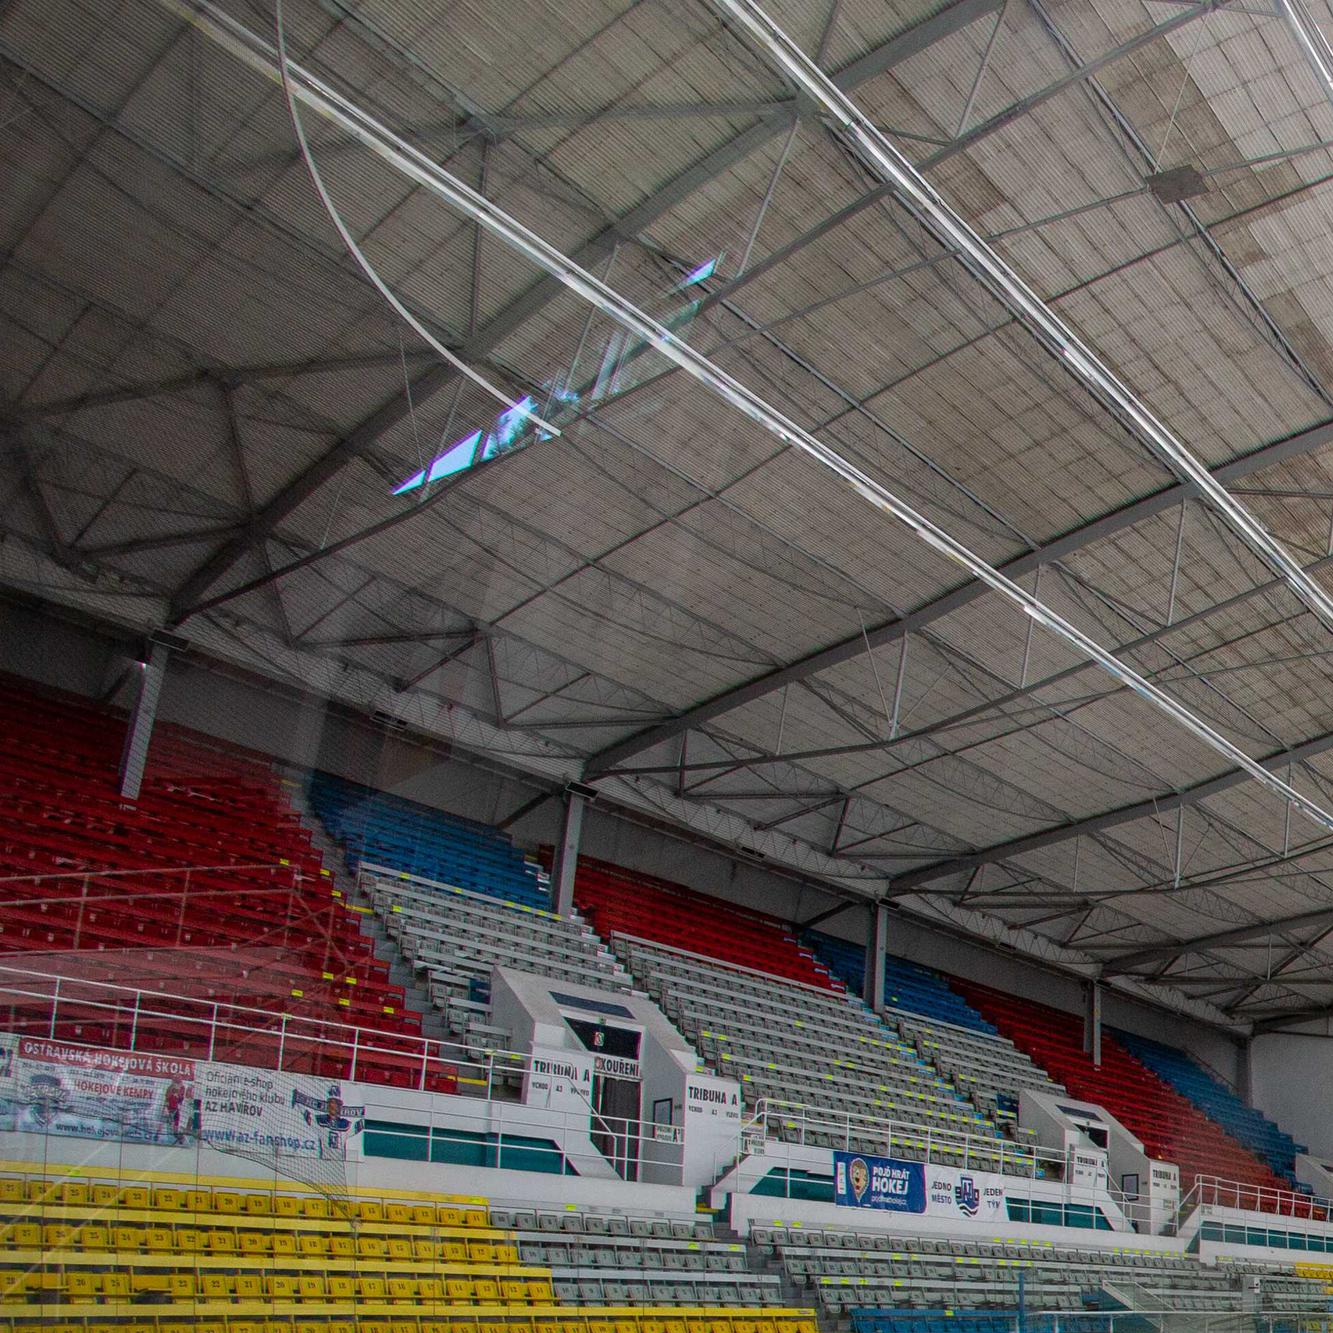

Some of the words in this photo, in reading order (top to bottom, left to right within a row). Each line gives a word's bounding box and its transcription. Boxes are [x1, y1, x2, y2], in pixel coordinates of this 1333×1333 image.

[23, 1041, 92, 1065] OSTRAVSKÁ
[155, 1057, 192, 1077] ŠKOLA
[689, 1086, 728, 1106] TRIBUNA
[732, 1096, 739, 1106] A
[204, 1101, 219, 1113] AZ
[872, 1177, 909, 1195] HOKEJ
